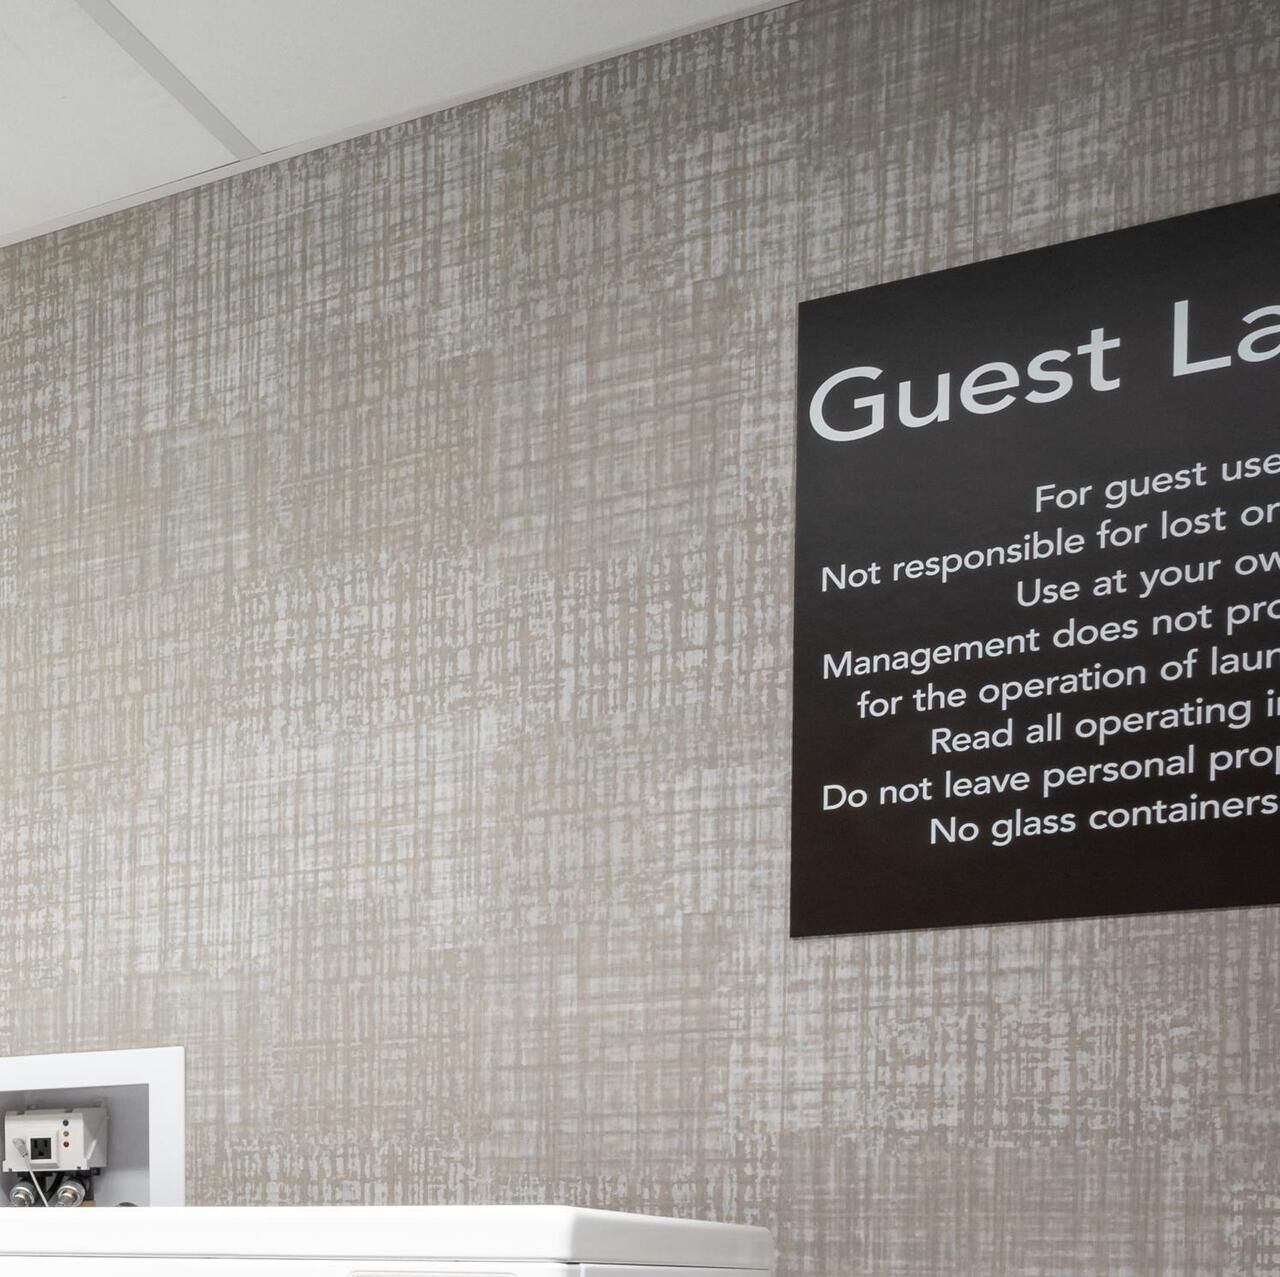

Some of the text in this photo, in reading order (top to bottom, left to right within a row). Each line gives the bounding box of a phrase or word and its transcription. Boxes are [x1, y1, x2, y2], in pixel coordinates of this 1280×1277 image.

[809, 300, 1280, 441] Guest La
[1036, 454, 1280, 512] For guest use
[822, 502, 1280, 592] Not responsible for lost or
[1018, 579, 1080, 606] Use
[1093, 570, 1127, 596] at
[1140, 560, 1221, 598] your
[824, 629, 1040, 679] Management
[1053, 618, 1138, 648] does
[1153, 605, 1212, 635] not
[857, 646, 1280, 718] for the operation of laun
[932, 689, 1280, 754] Read all operating i
[823, 744, 1280, 810] Do not leave personal pro
[931, 794, 1278, 846] No glass containers
